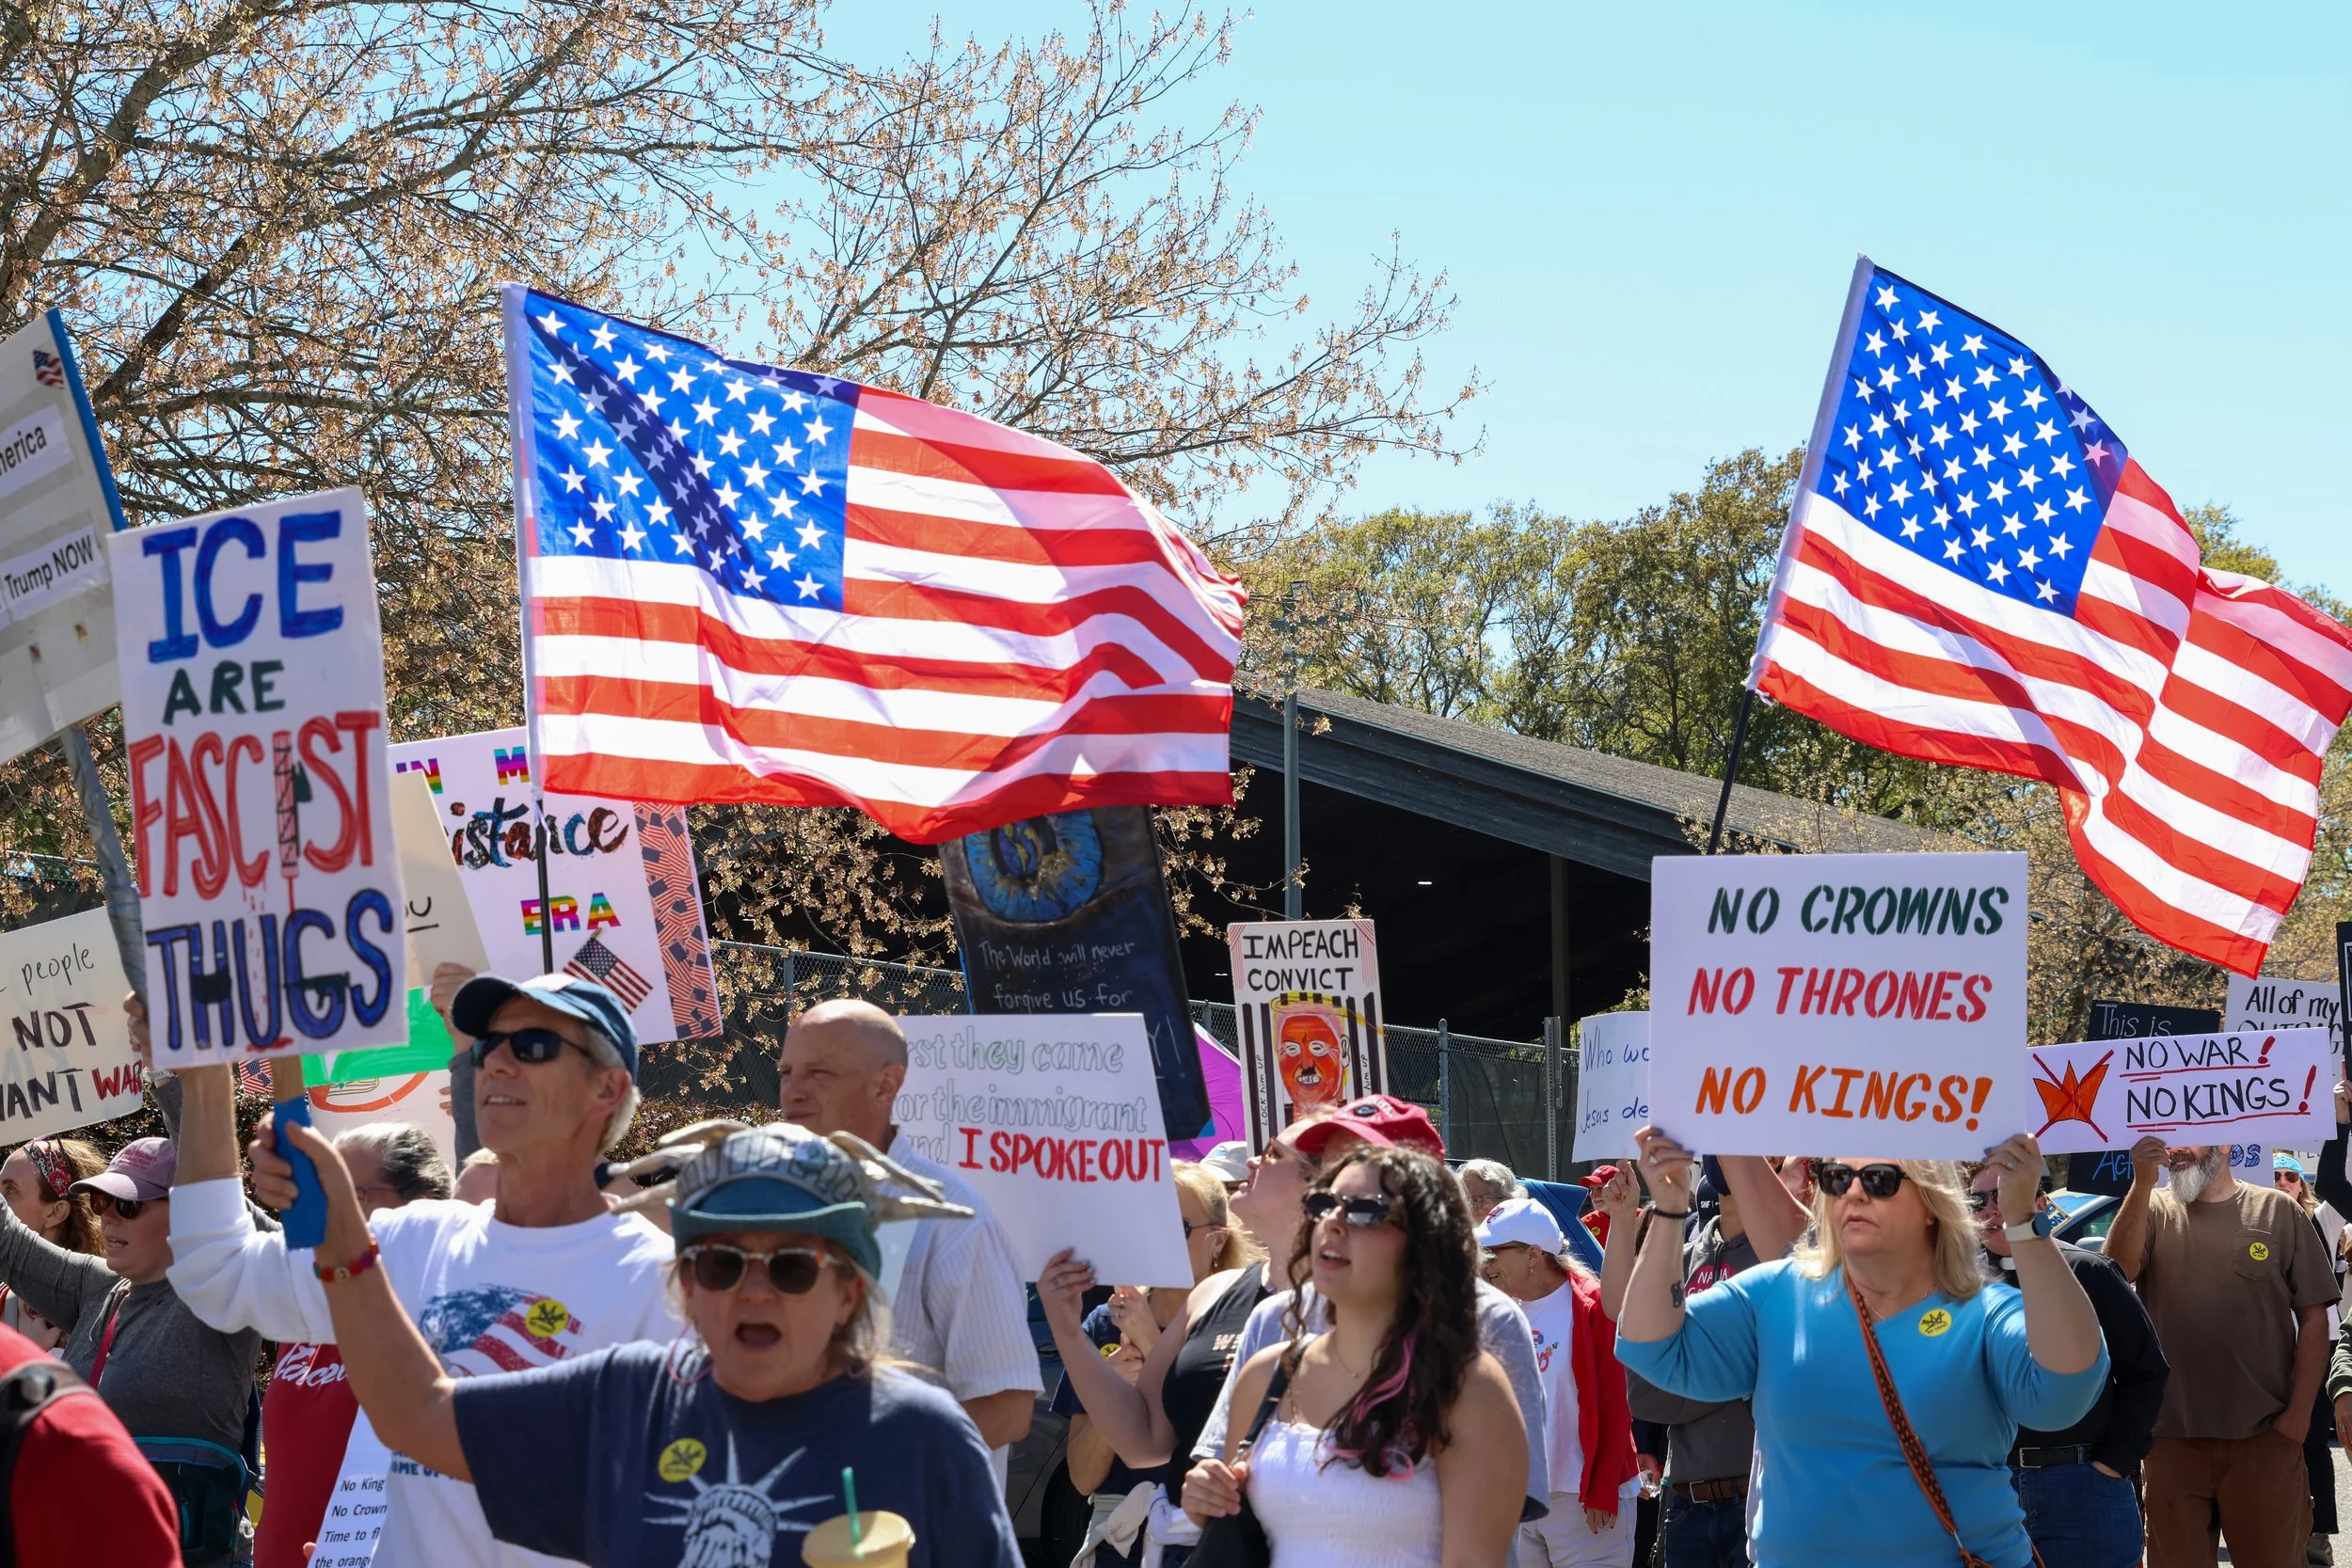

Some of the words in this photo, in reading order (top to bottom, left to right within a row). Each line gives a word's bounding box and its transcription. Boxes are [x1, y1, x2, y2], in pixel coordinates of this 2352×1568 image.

[5, 562, 54, 599] Trump
[53, 535, 94, 575] NOW
[141, 509, 343, 663] ICE
[163, 660, 286, 725] ARE
[396, 758, 443, 794] N
[128, 711, 380, 900] FASCIST
[520, 892, 622, 936] ERA
[1708, 887, 1780, 935] NO
[1800, 885, 2010, 936] CROWNS
[978, 941, 1006, 971] The
[1057, 943, 1086, 965] will
[1091, 942, 1135, 960] never
[1243, 928, 1359, 959] IMPEACH
[22, 942, 94, 996] people
[145, 888, 394, 1051] THUGS
[1248, 967, 1354, 991] CONVICT
[993, 983, 1054, 1015] forgive
[1062, 989, 1086, 1008] us
[1096, 983, 1134, 1007] for
[1688, 967, 1755, 1017] NO
[1776, 967, 1993, 1022] THRONES
[2245, 986, 2276, 1013] All
[2279, 989, 2304, 1014] of
[2309, 997, 2340, 1029] my
[12, 1002, 96, 1052] NOT
[2096, 1003, 2139, 1037] This
[2149, 1016, 2171, 1037] is
[951, 1025, 1025, 1074] they
[1032, 1040, 1124, 1073] came
[1583, 1025, 1613, 1072] Who
[2125, 1040, 2168, 1069] NO
[91, 1059, 143, 1101] WAR
[1695, 1066, 1766, 1115] NO
[1788, 1064, 1994, 1132] KINGS!
[896, 1093, 929, 1122] or
[1581, 1088, 1610, 1134] Jesus
[2126, 1085, 2176, 1123] NO
[959, 1127, 983, 1169] I
[340, 1480, 357, 1493] No
[361, 1477, 386, 1493] King
[331, 1505, 347, 1518] No
[353, 1503, 388, 1517] Crown
[325, 1530, 351, 1544] Time
[355, 1529, 367, 1542] to
[315, 1557, 332, 1568] the
